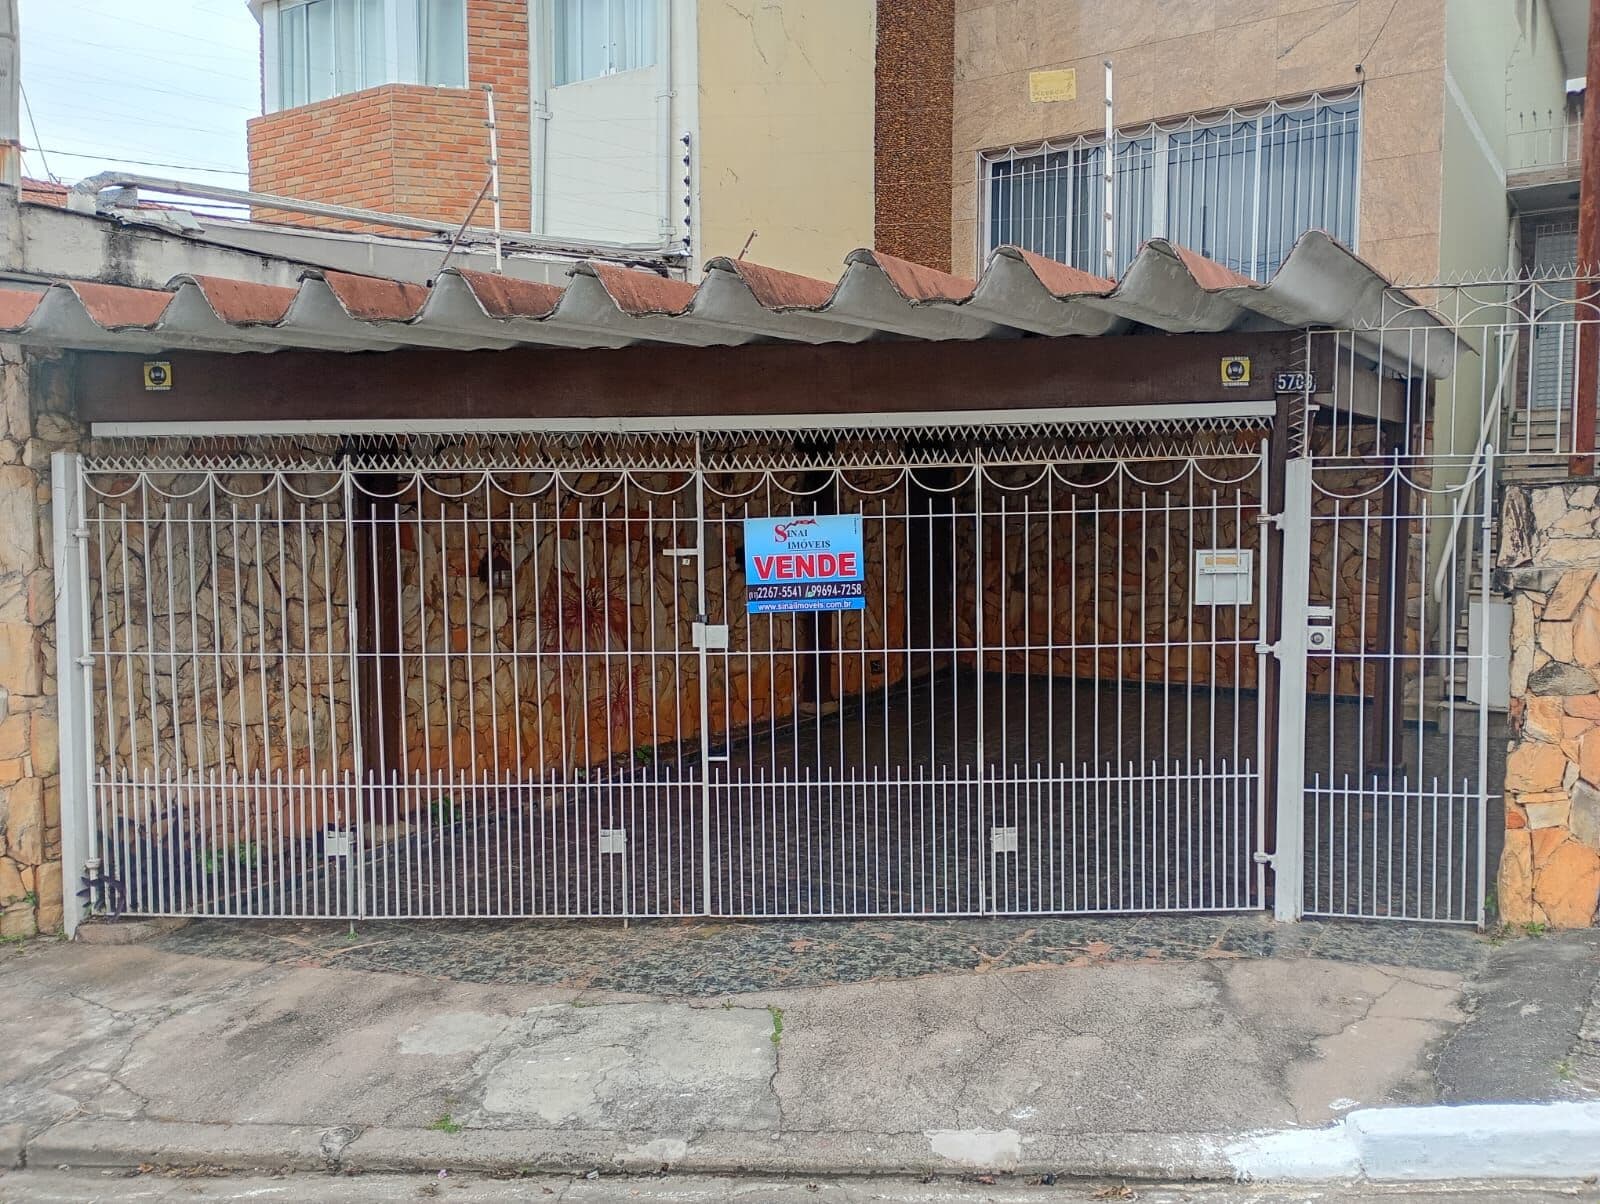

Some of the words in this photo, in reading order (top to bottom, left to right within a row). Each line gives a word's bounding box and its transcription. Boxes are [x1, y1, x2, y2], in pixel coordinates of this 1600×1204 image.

[774, 524, 808, 542] SINAI
[753, 552, 857, 580] VENDE
[811, 583, 862, 597] 99694-7258
[758, 601, 852, 611] www.sinaiimoveis.com.br
